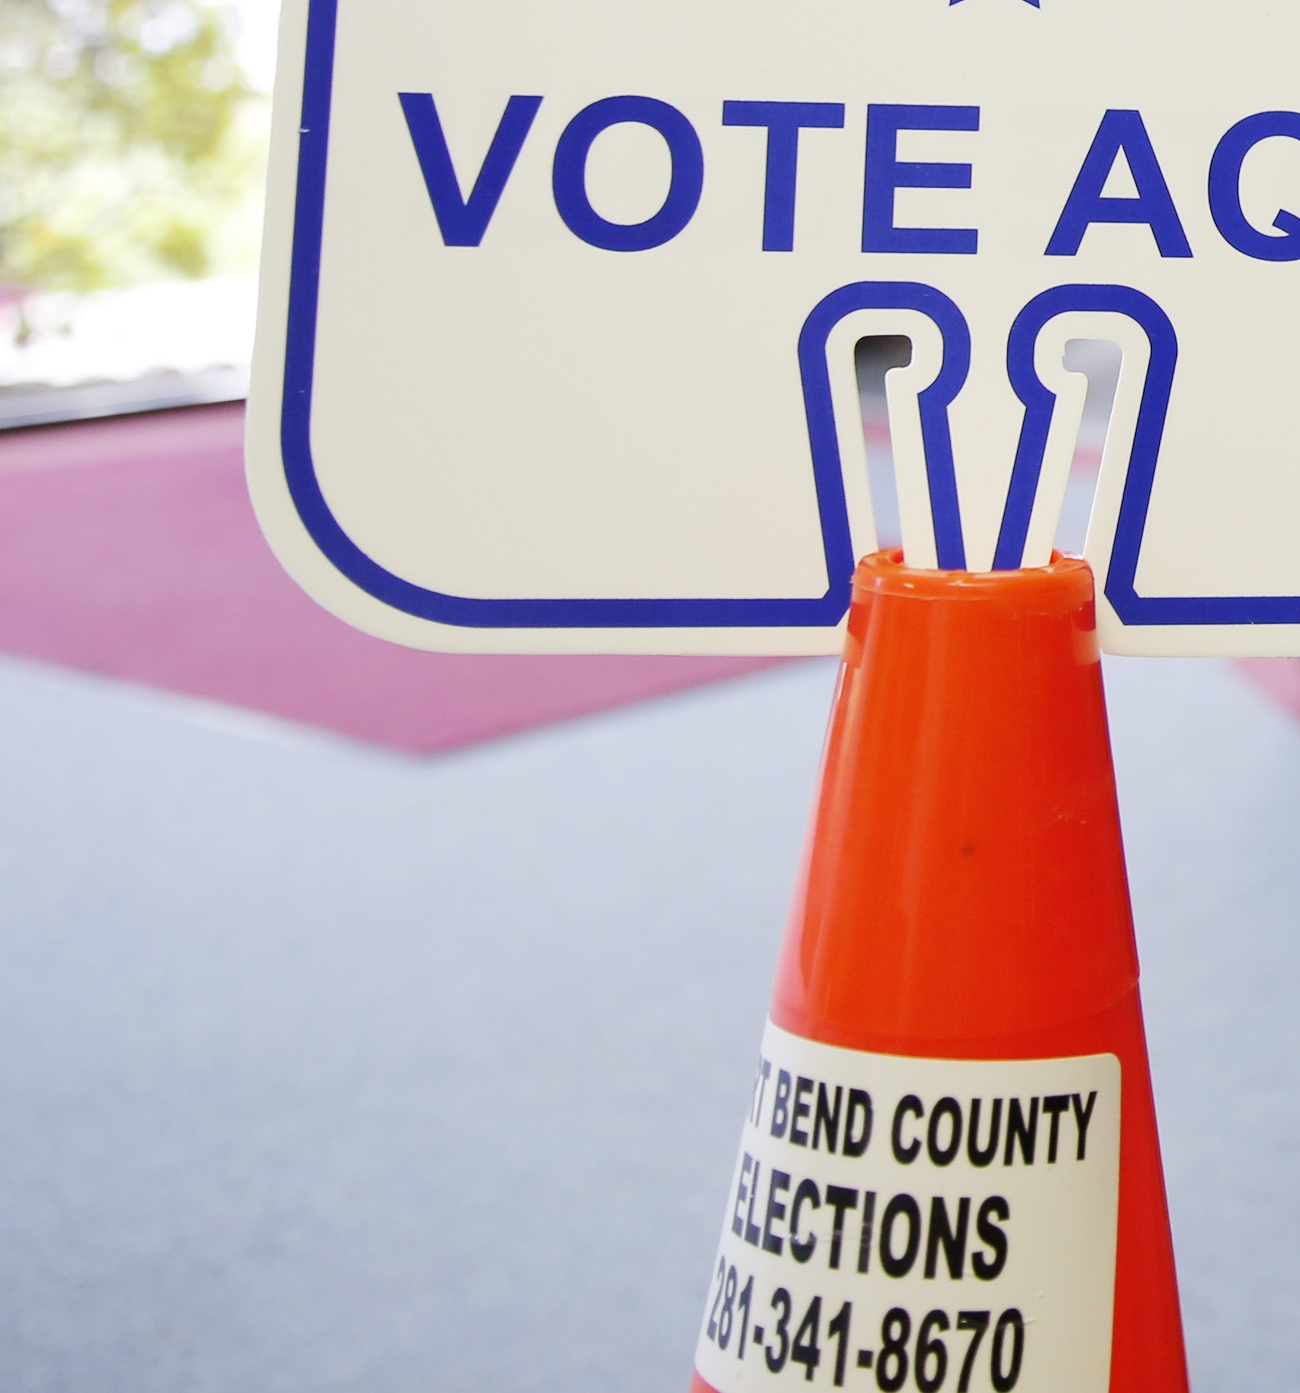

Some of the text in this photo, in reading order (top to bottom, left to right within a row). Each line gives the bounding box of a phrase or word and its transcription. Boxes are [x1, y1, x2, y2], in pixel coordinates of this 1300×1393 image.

[398, 92, 981, 255] VOTE
[770, 1068, 873, 1158] BEND
[891, 1090, 1098, 1167] COUNTY
[731, 1151, 1010, 1281] ELECTIONS
[706, 1255, 1025, 1393] 281-341-8670
